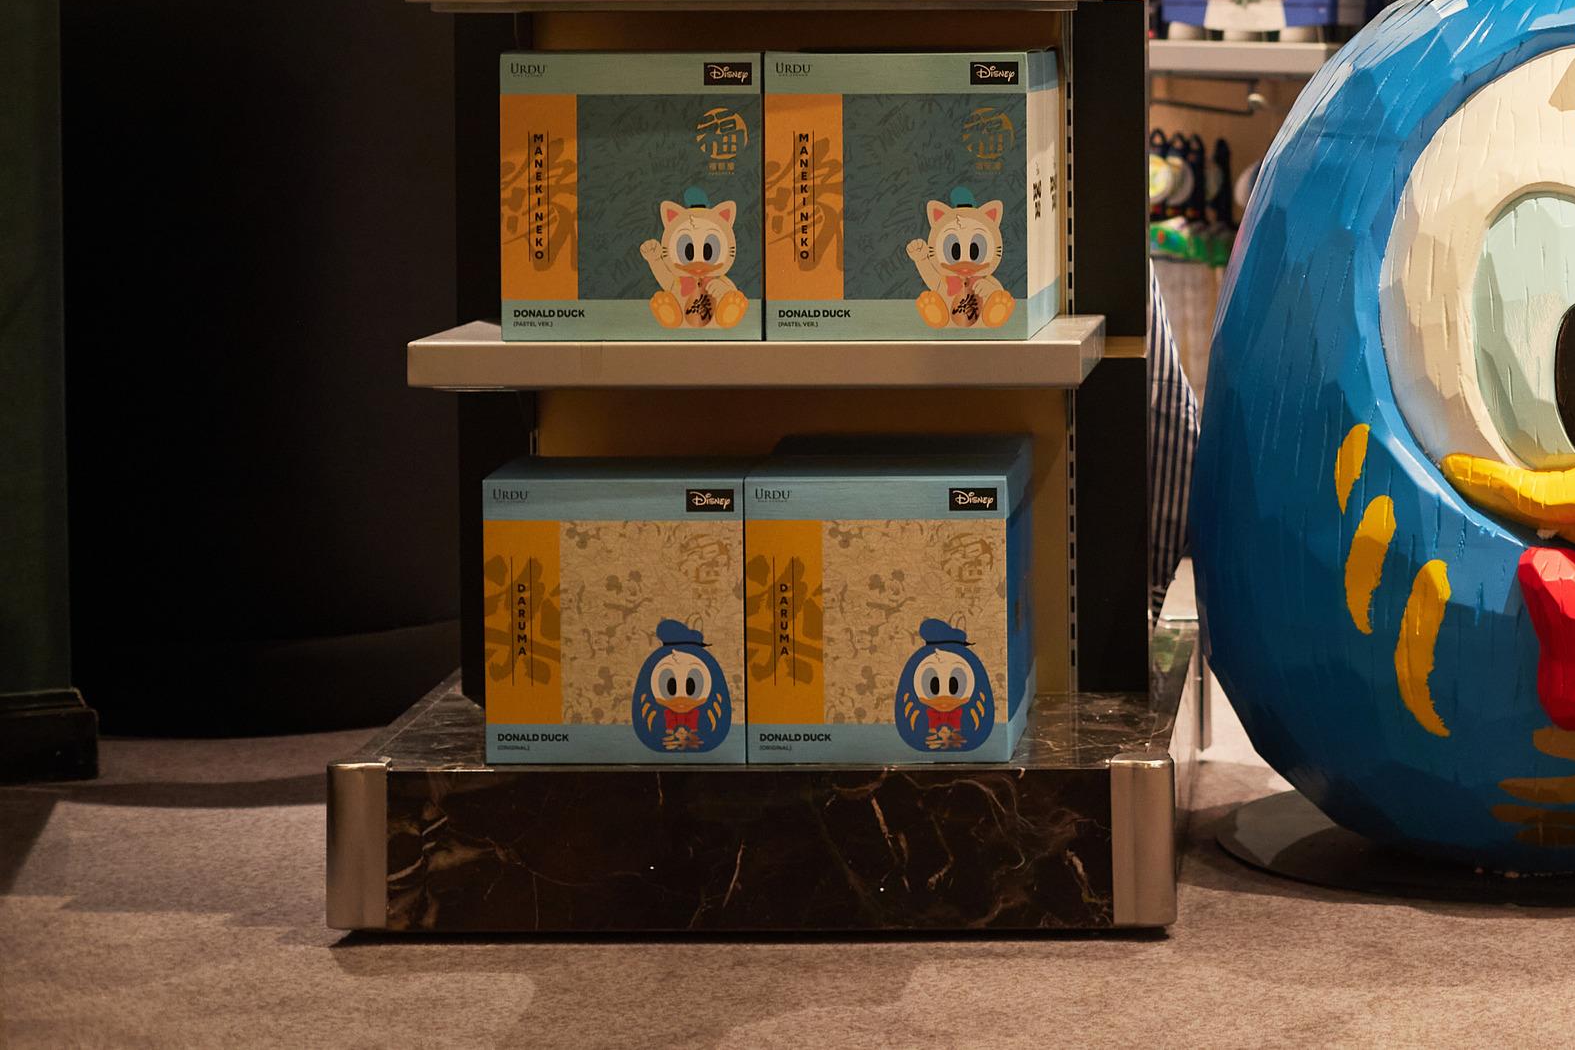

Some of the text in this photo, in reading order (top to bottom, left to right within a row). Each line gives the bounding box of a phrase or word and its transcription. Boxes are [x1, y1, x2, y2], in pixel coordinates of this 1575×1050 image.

[510, 62, 546, 75] URDU
[707, 64, 749, 83] Disney
[775, 62, 811, 74] URDU
[973, 63, 1016, 83] Disney
[533, 133, 545, 260] MANEKINEKO
[798, 133, 810, 260] MANEKINEKO
[513, 309, 585, 318] DONALD DUCK
[778, 309, 851, 318] DONALD DUCK
[492, 488, 528, 500] URDU
[689, 491, 731, 509] Disney
[754, 487, 790, 499] URDU
[952, 490, 994, 509] Disney
[517, 583, 528, 656] DARUMA
[779, 583, 790, 656] DARUMA
[497, 733, 569, 742] DONALD DUCK
[759, 733, 832, 742] DONALD DUCK
